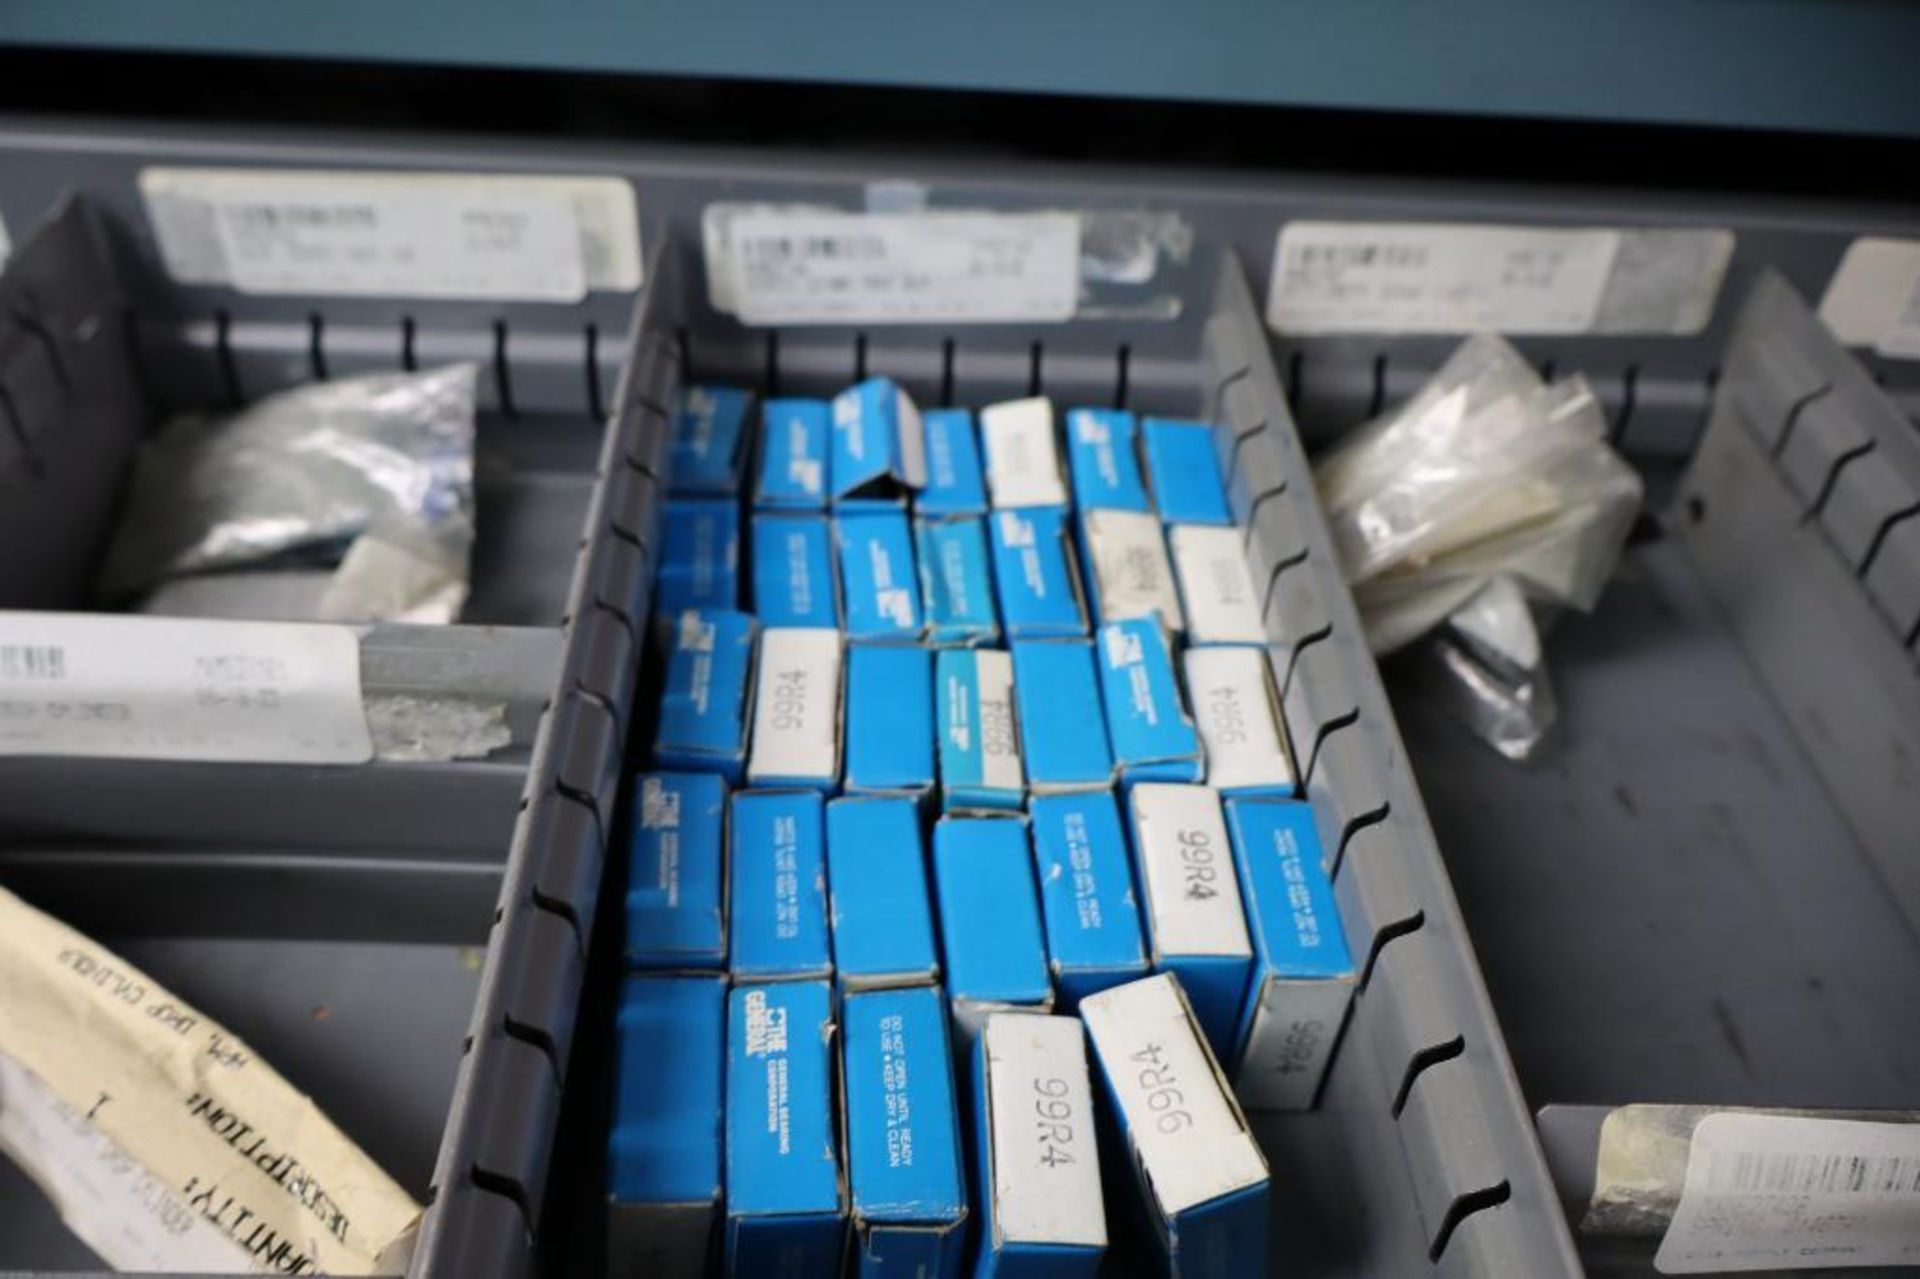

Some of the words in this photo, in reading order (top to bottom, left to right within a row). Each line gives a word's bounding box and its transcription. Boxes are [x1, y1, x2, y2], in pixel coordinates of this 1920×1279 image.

[771, 669, 808, 731] 99R4
[1208, 685, 1248, 745] 99R4
[1178, 830, 1220, 902] 99R4
[745, 990, 766, 1056] GENERAL
[883, 1063, 895, 1091] KEEP
[885, 1093, 897, 1116] DRY
[1130, 1043, 1193, 1135] 99R4
[896, 1092, 909, 1123] UNTIL
[1033, 1078, 1077, 1168] 99R4
[887, 1129, 900, 1168] CLEAN
[899, 1127, 913, 1167] READY
